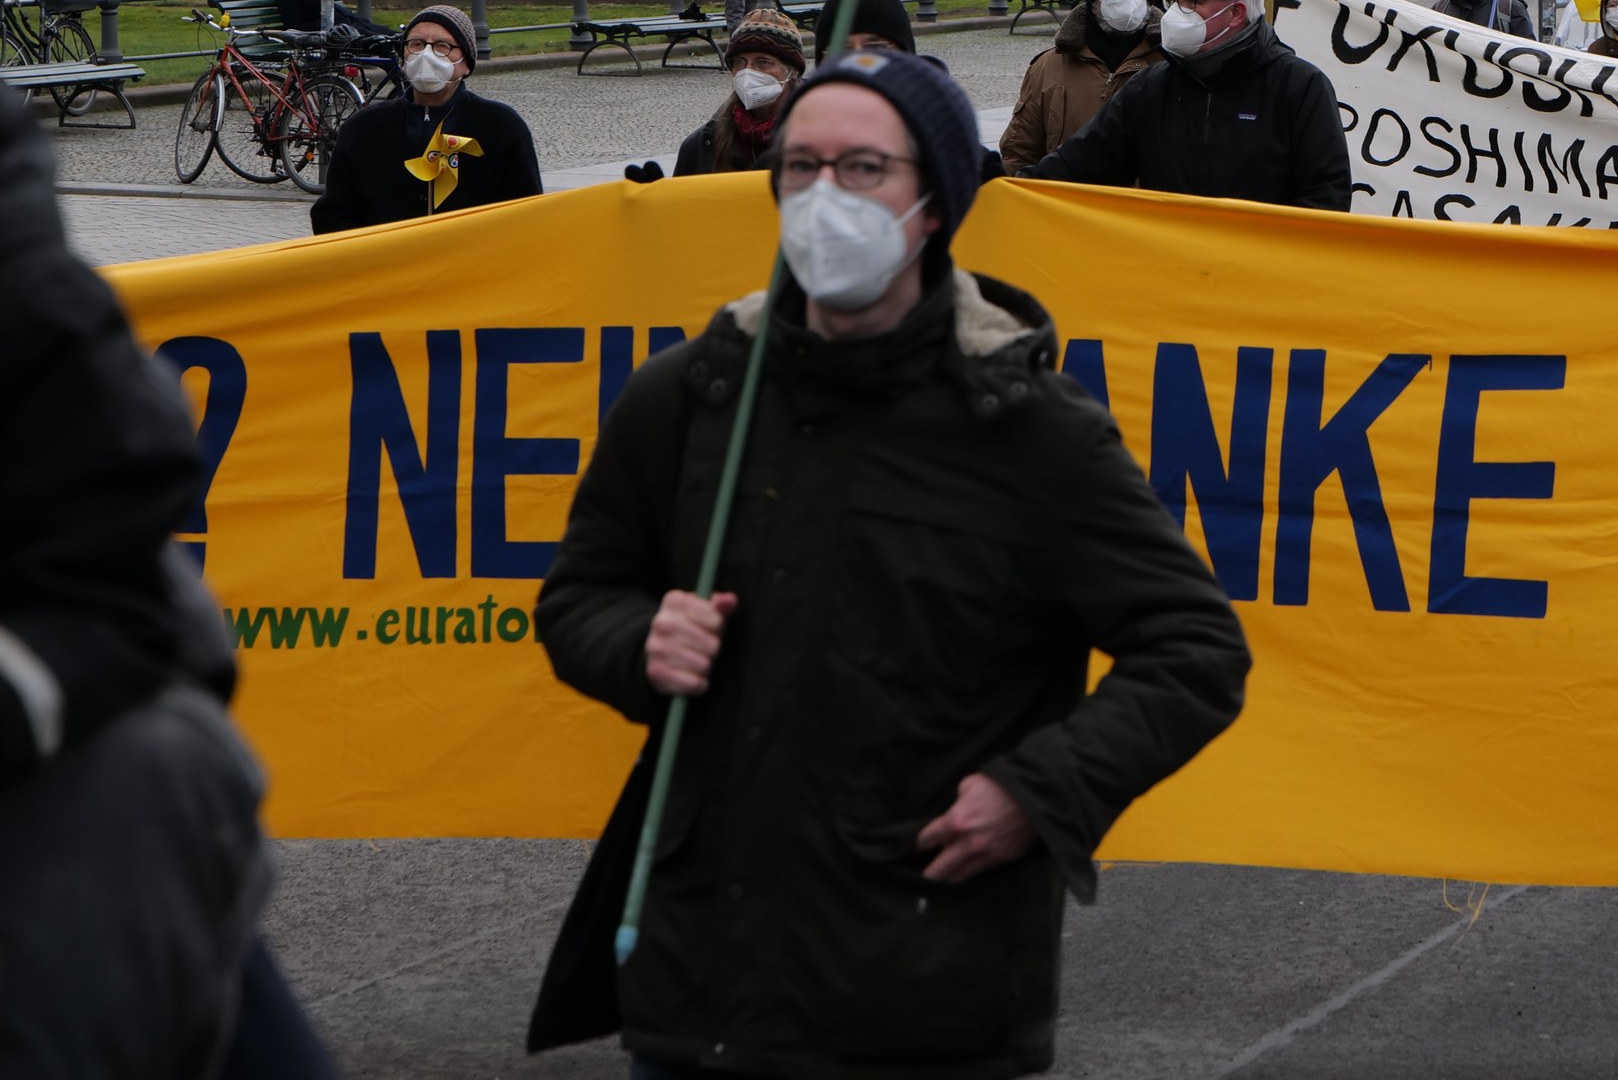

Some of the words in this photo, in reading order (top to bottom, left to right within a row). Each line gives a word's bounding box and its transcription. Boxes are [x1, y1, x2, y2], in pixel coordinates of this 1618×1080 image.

[343, 326, 686, 580] NE
[1061, 339, 1567, 618] NKE
[223, 594, 542, 650] www.eurato
